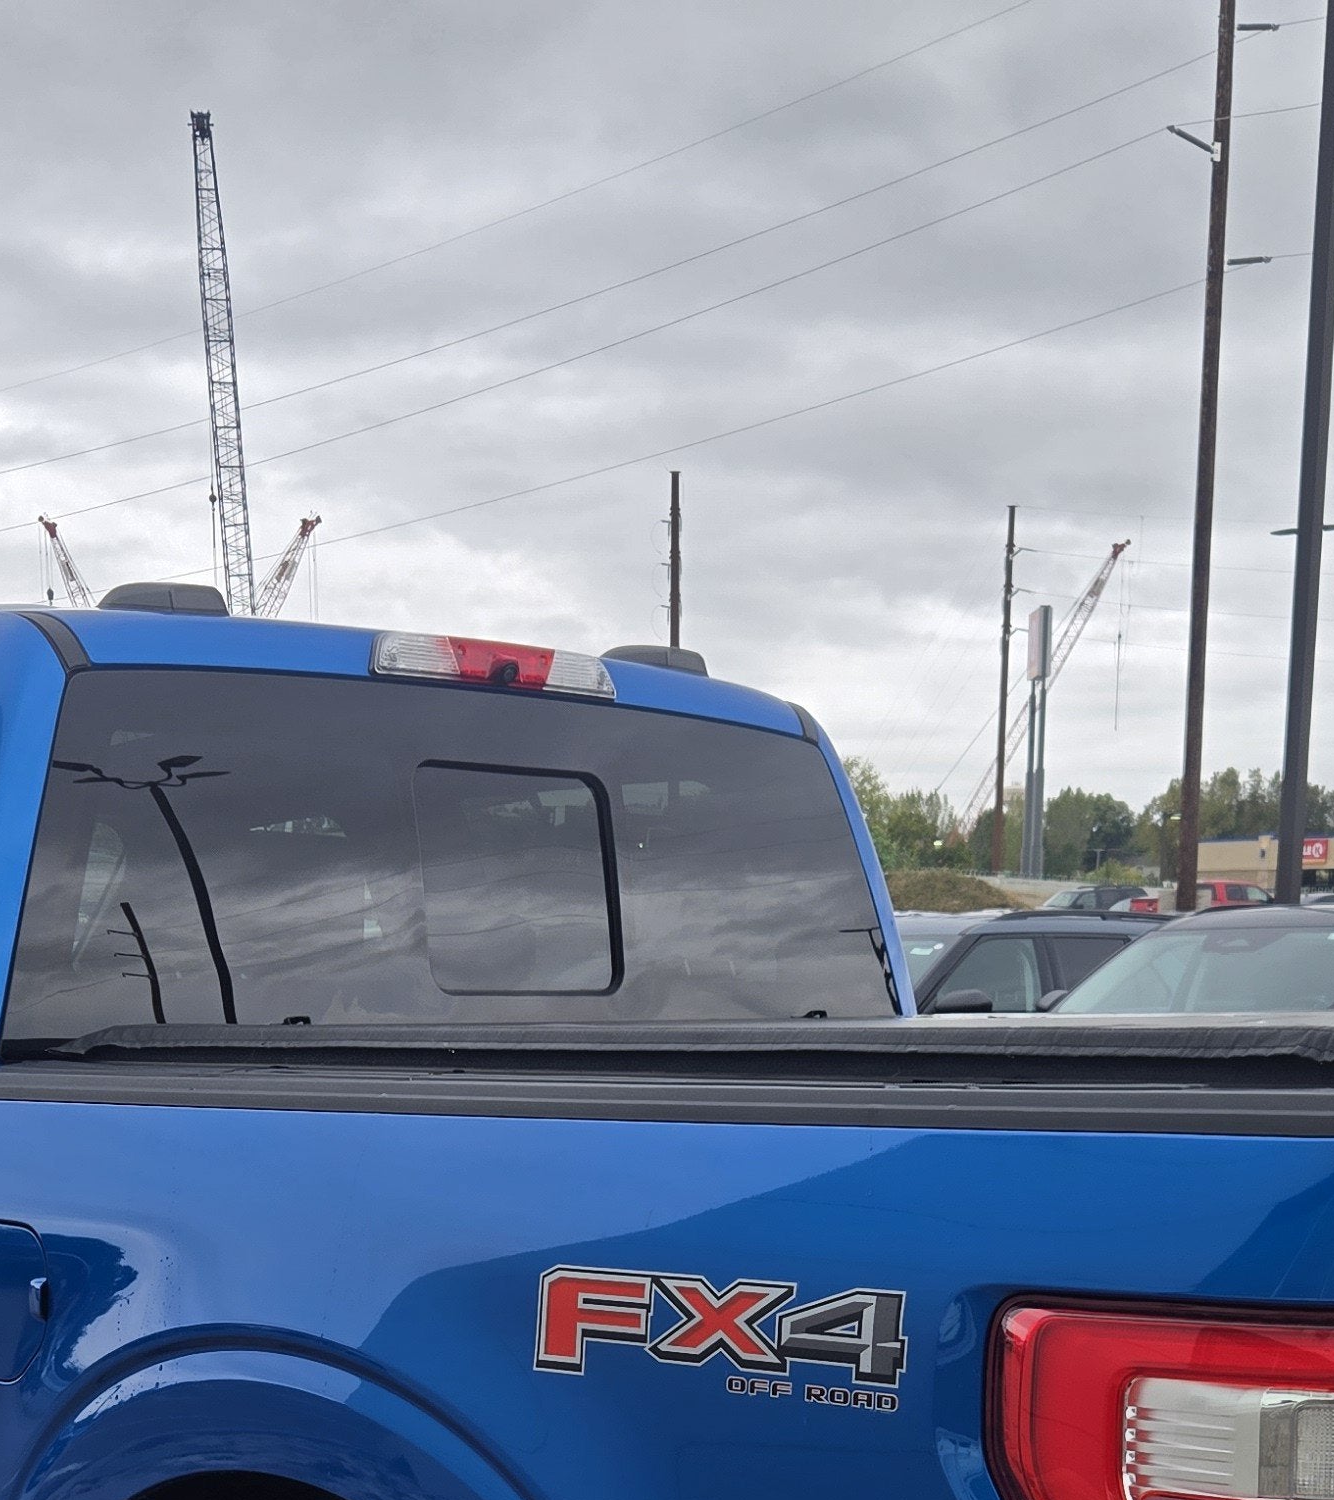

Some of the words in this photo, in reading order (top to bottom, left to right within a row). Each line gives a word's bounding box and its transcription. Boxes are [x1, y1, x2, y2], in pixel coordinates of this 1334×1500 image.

[533, 1264, 906, 1388] FX4
[726, 1375, 793, 1399] OFF
[804, 1384, 900, 1413] ROAD
